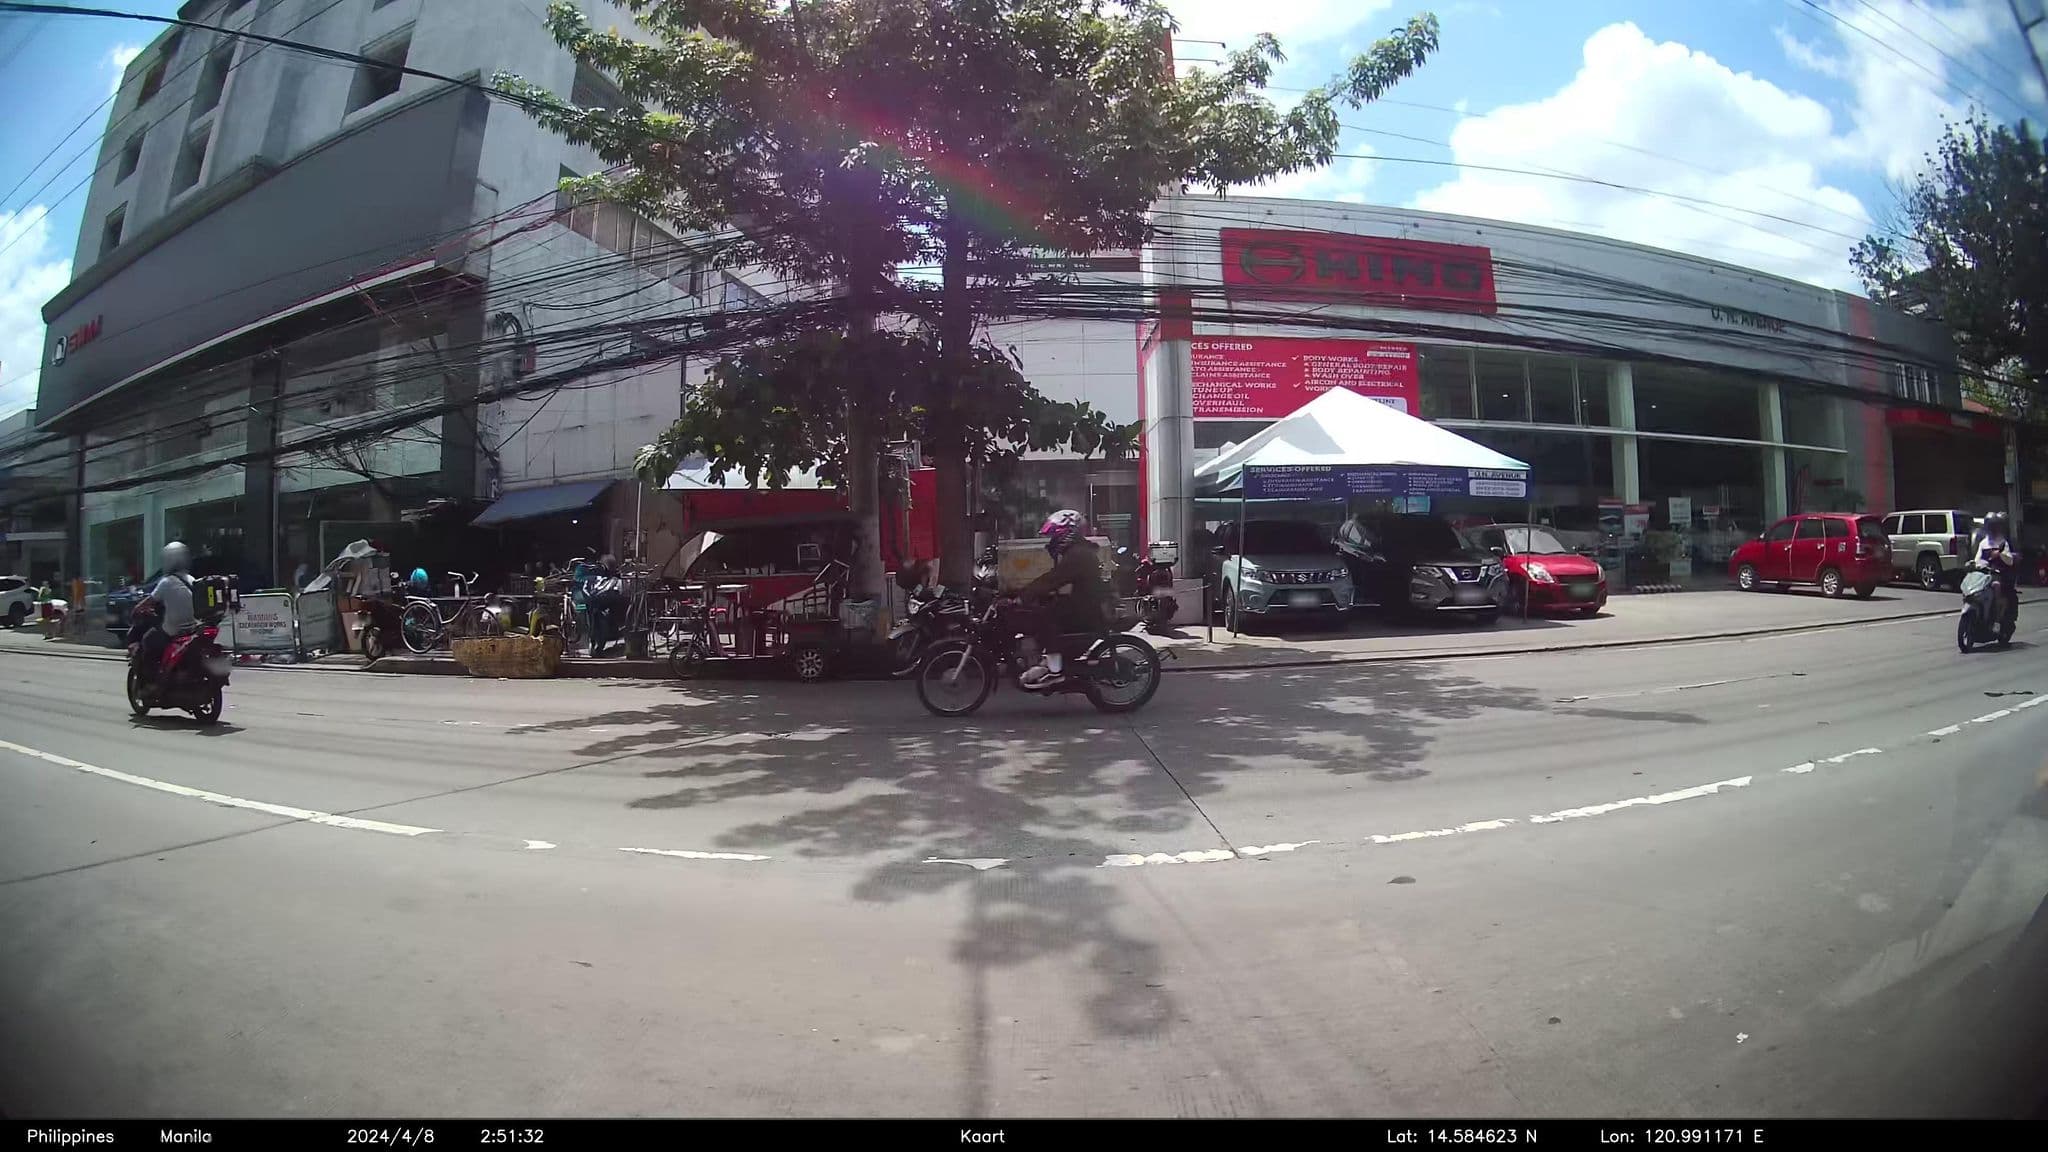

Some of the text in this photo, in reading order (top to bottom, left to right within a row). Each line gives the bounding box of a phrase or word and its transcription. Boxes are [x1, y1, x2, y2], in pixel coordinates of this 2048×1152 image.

[1316, 251, 1481, 291] HINO
[1191, 342, 1253, 351] CES OFFERED
